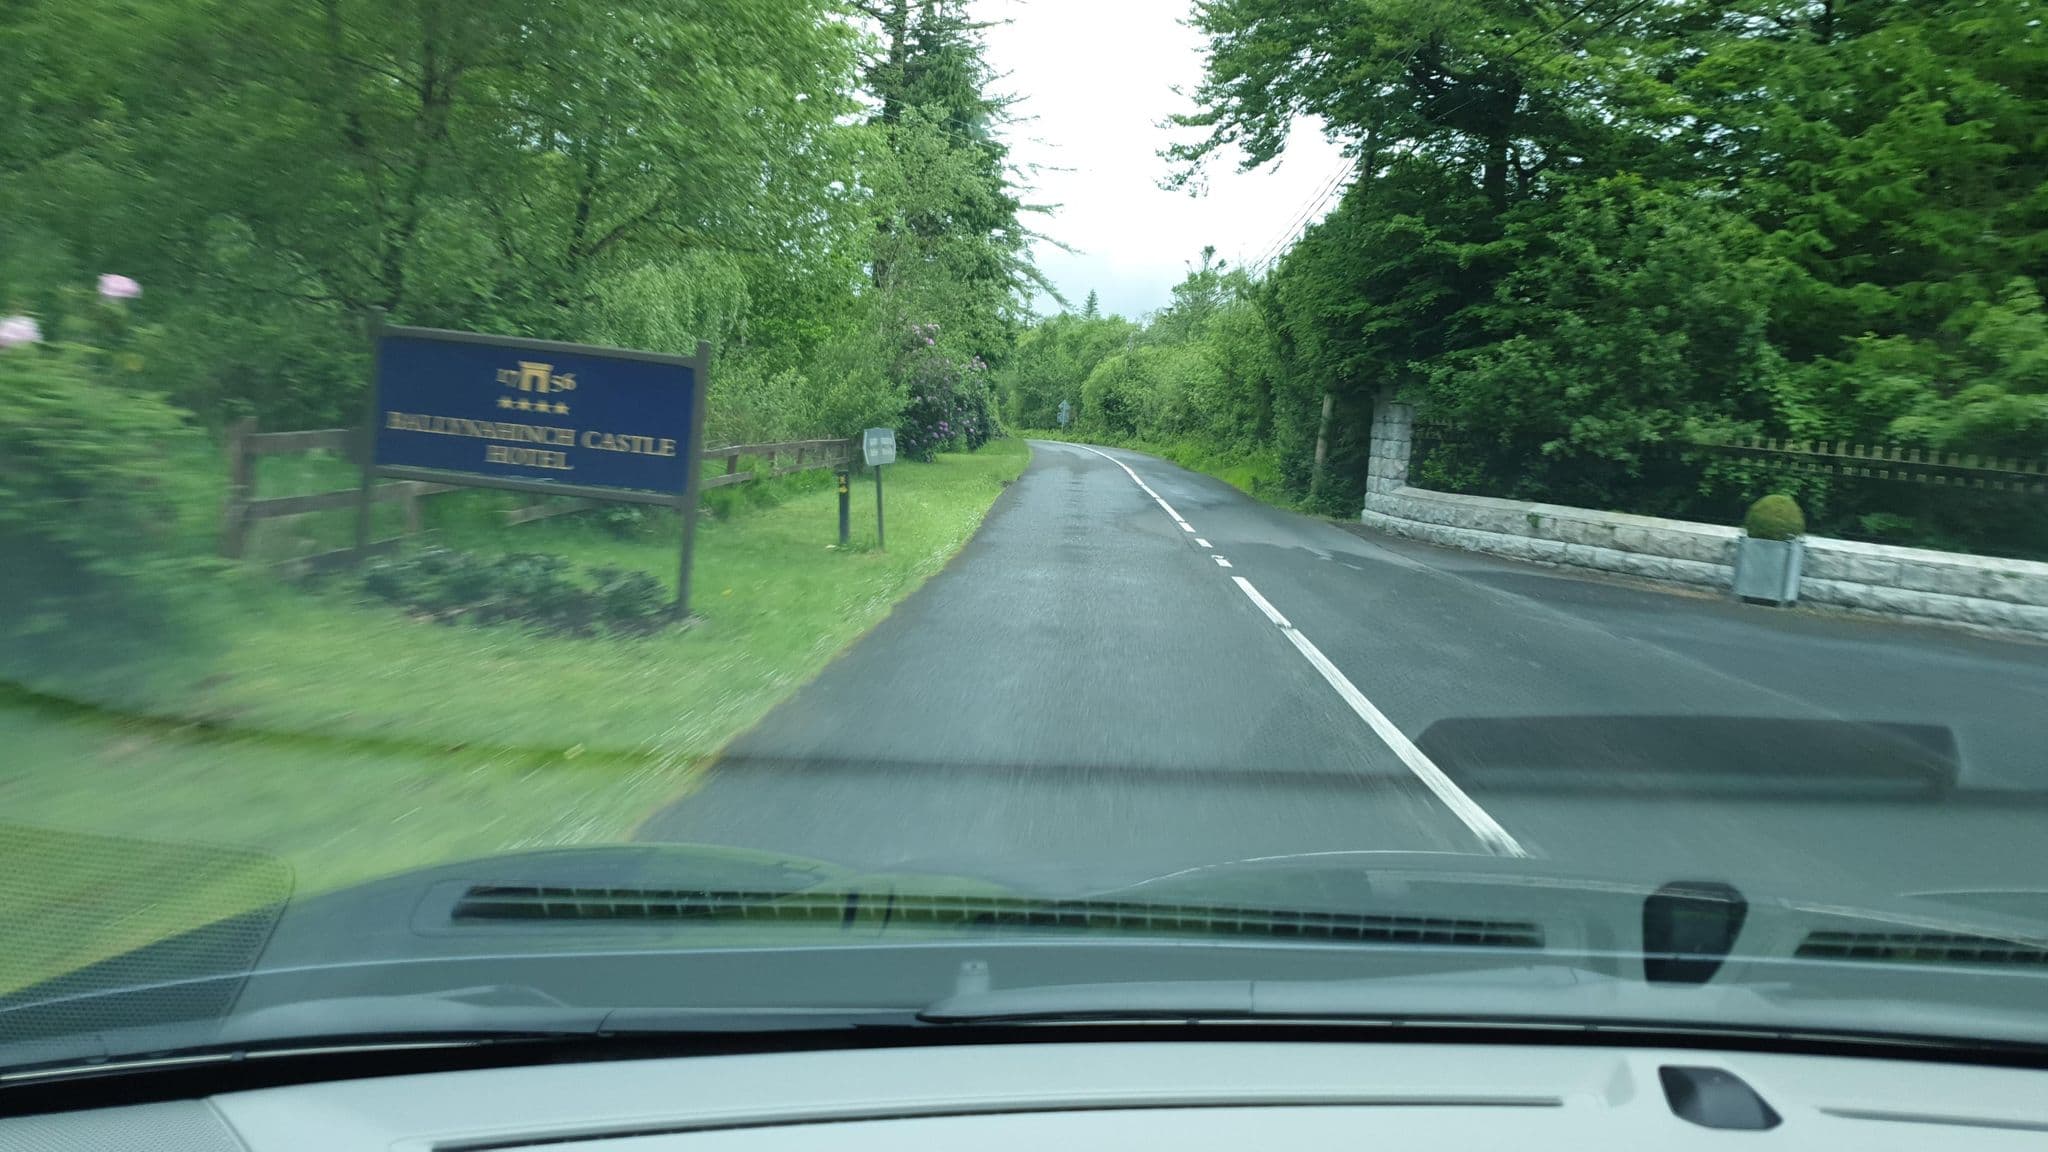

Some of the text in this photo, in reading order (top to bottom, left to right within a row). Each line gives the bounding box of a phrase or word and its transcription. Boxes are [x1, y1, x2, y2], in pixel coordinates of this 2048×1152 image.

[385, 411, 677, 457] BALLYNAHINCH CASTLE
[485, 445, 575, 470] HOTEL
